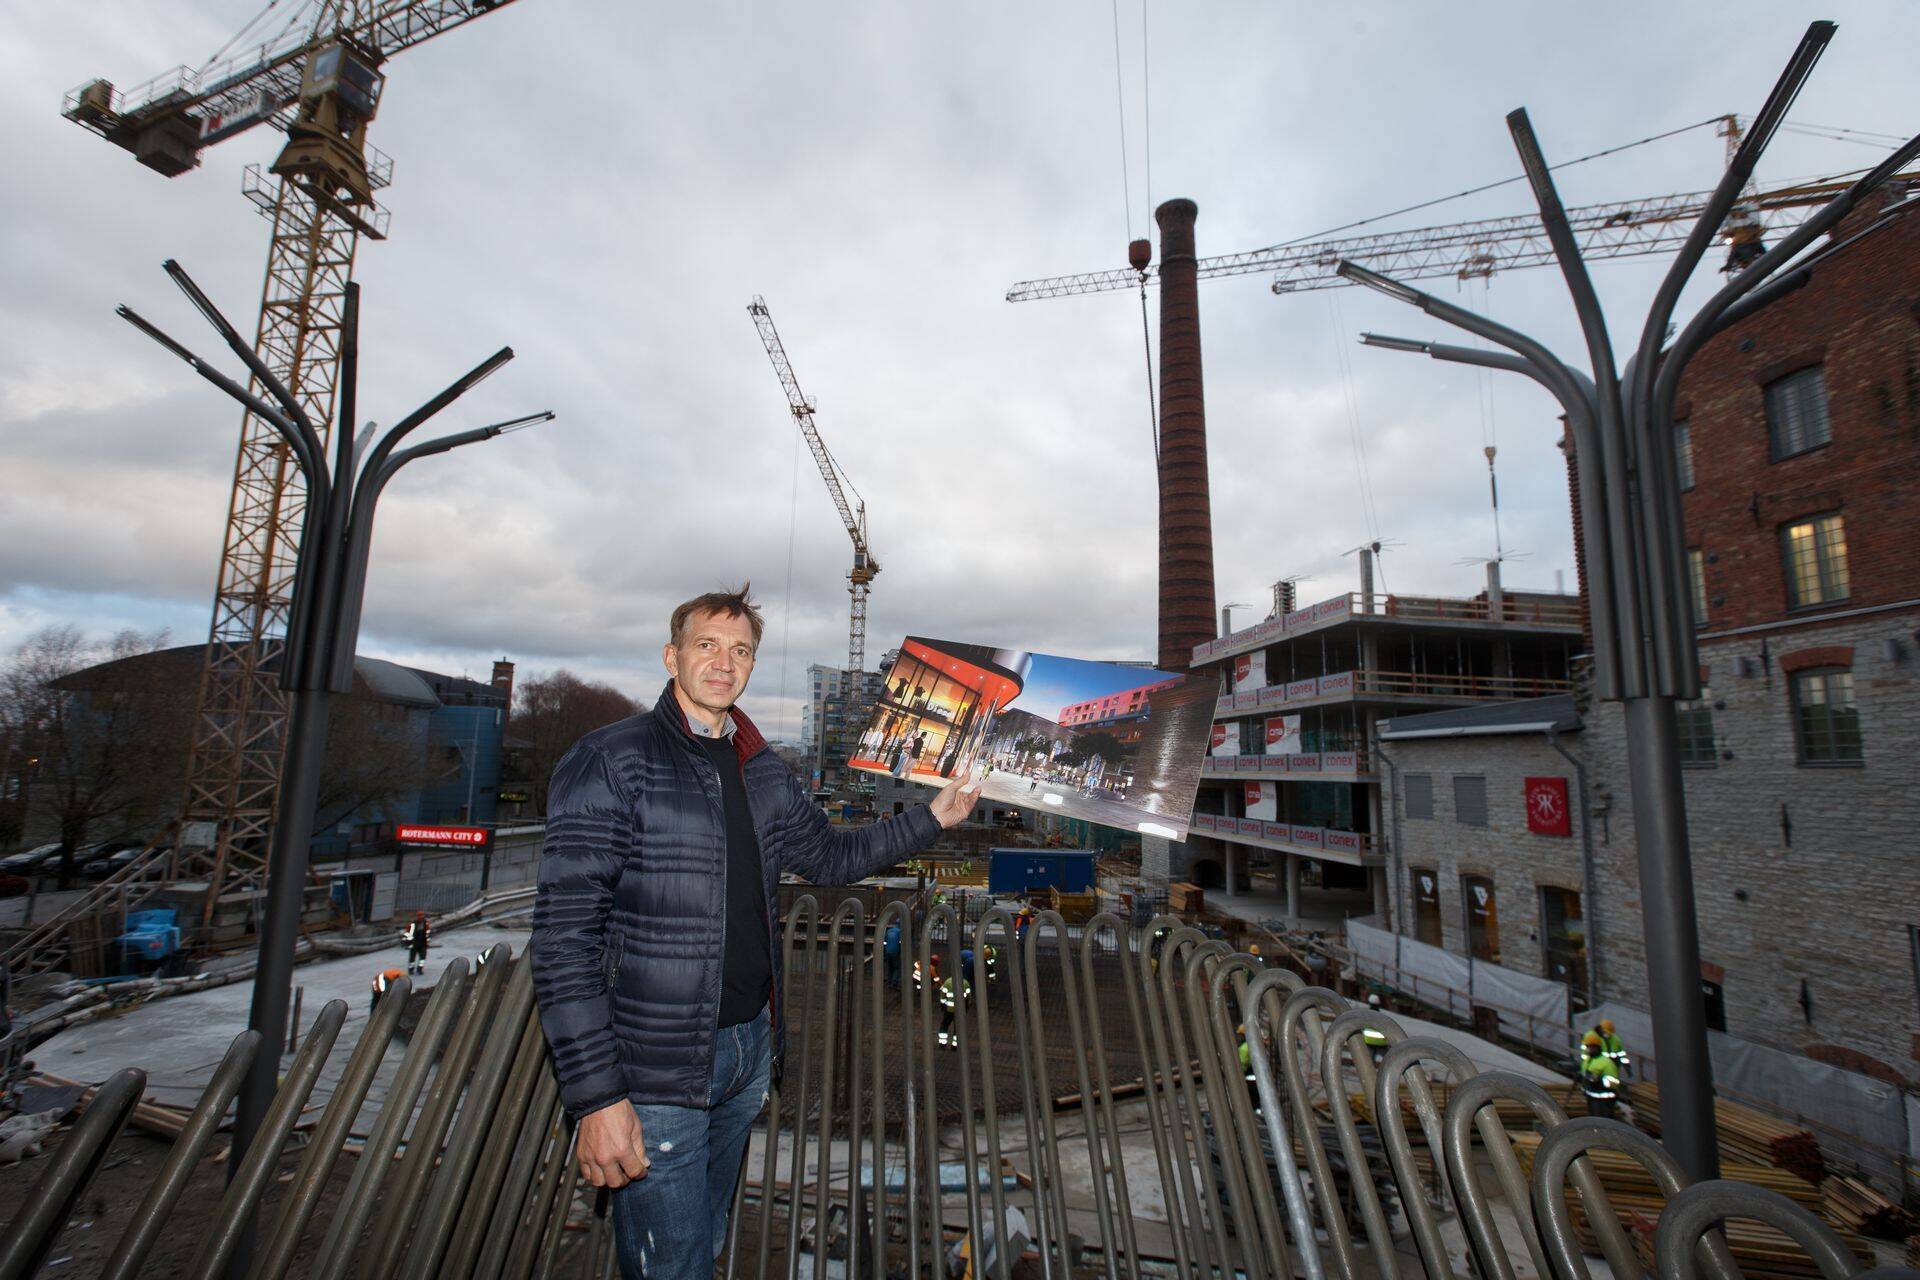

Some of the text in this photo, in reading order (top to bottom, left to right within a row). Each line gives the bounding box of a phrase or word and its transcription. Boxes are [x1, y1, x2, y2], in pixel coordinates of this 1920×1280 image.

[1320, 598, 1345, 615] conex
[1290, 609, 1313, 626] conex
[1290, 682, 1313, 695] conex
[1323, 676, 1349, 690] conex
[1263, 688, 1282, 700] conex
[1264, 757, 1285, 767] conex
[1293, 758, 1317, 767] conex
[1327, 756, 1353, 767] conex
[1198, 816, 1214, 825] conex
[1219, 819, 1235, 828] conex
[1241, 822, 1261, 832] conex
[1267, 826, 1288, 836] conex
[401, 829, 473, 841] ROTERMANN CITY
[1296, 830, 1320, 841] conex
[1329, 834, 1358, 847] conex
